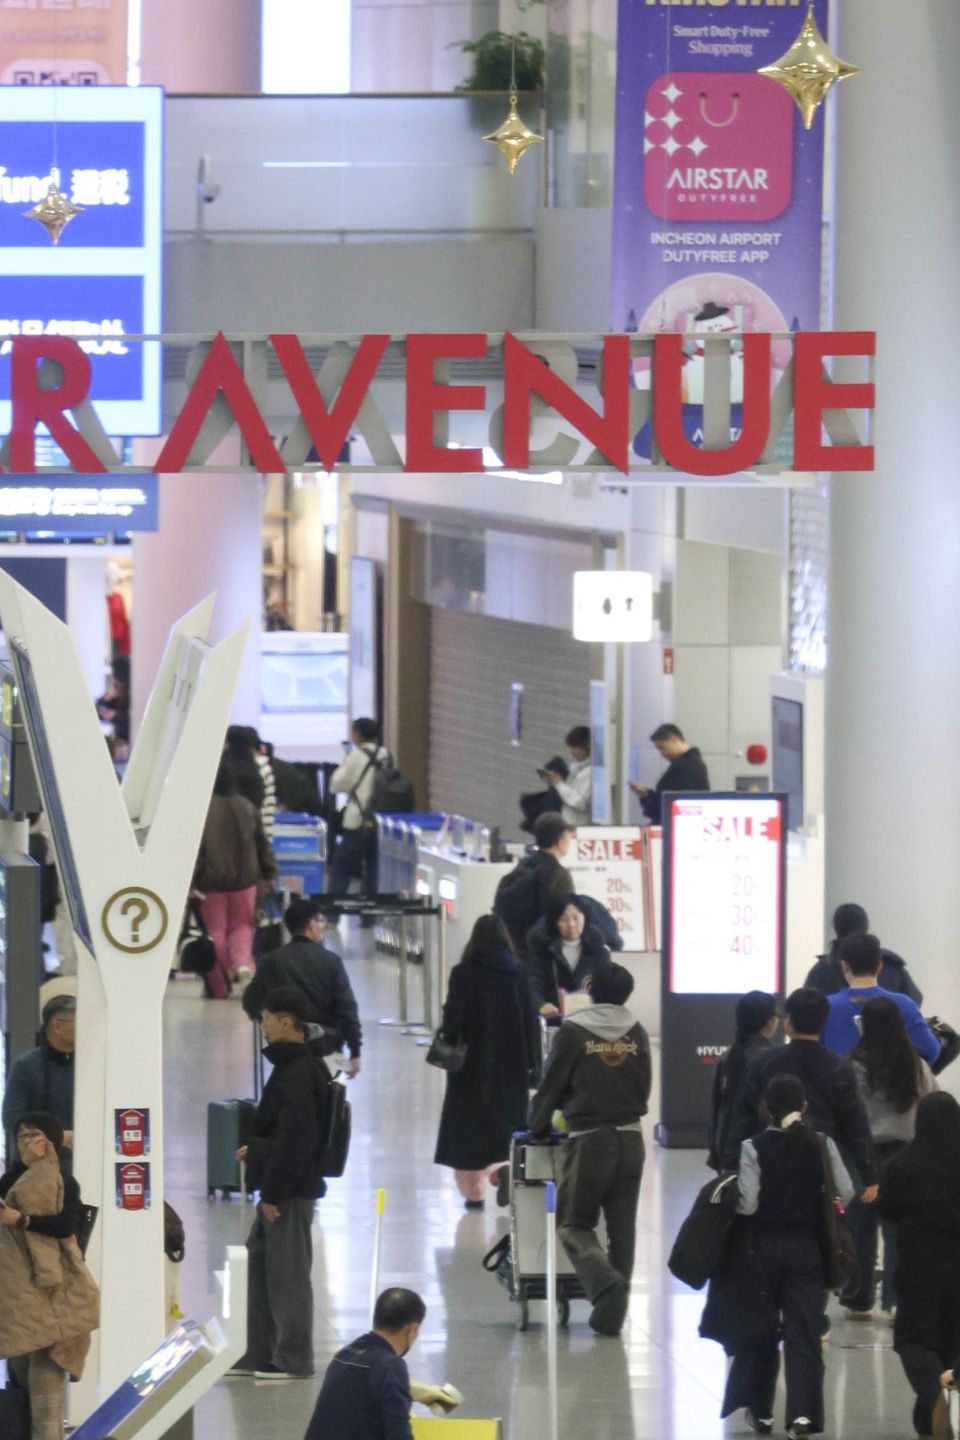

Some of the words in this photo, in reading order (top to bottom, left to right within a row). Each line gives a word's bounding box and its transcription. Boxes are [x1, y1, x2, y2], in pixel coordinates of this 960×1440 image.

[673, 25, 709, 37] Smart
[688, 40, 754, 57] Shopping
[665, 167, 769, 190] AIRSTAR
[677, 193, 757, 203] DUTYFREE
[650, 232, 716, 245] INCHEON
[719, 232, 782, 245] AIRPORT
[662, 250, 737, 263] DUTYFREE
[740, 250, 770, 263] APP
[152, 329, 877, 476] AVENUE
[702, 816, 769, 842] SALE
[577, 839, 635, 861] SALE
